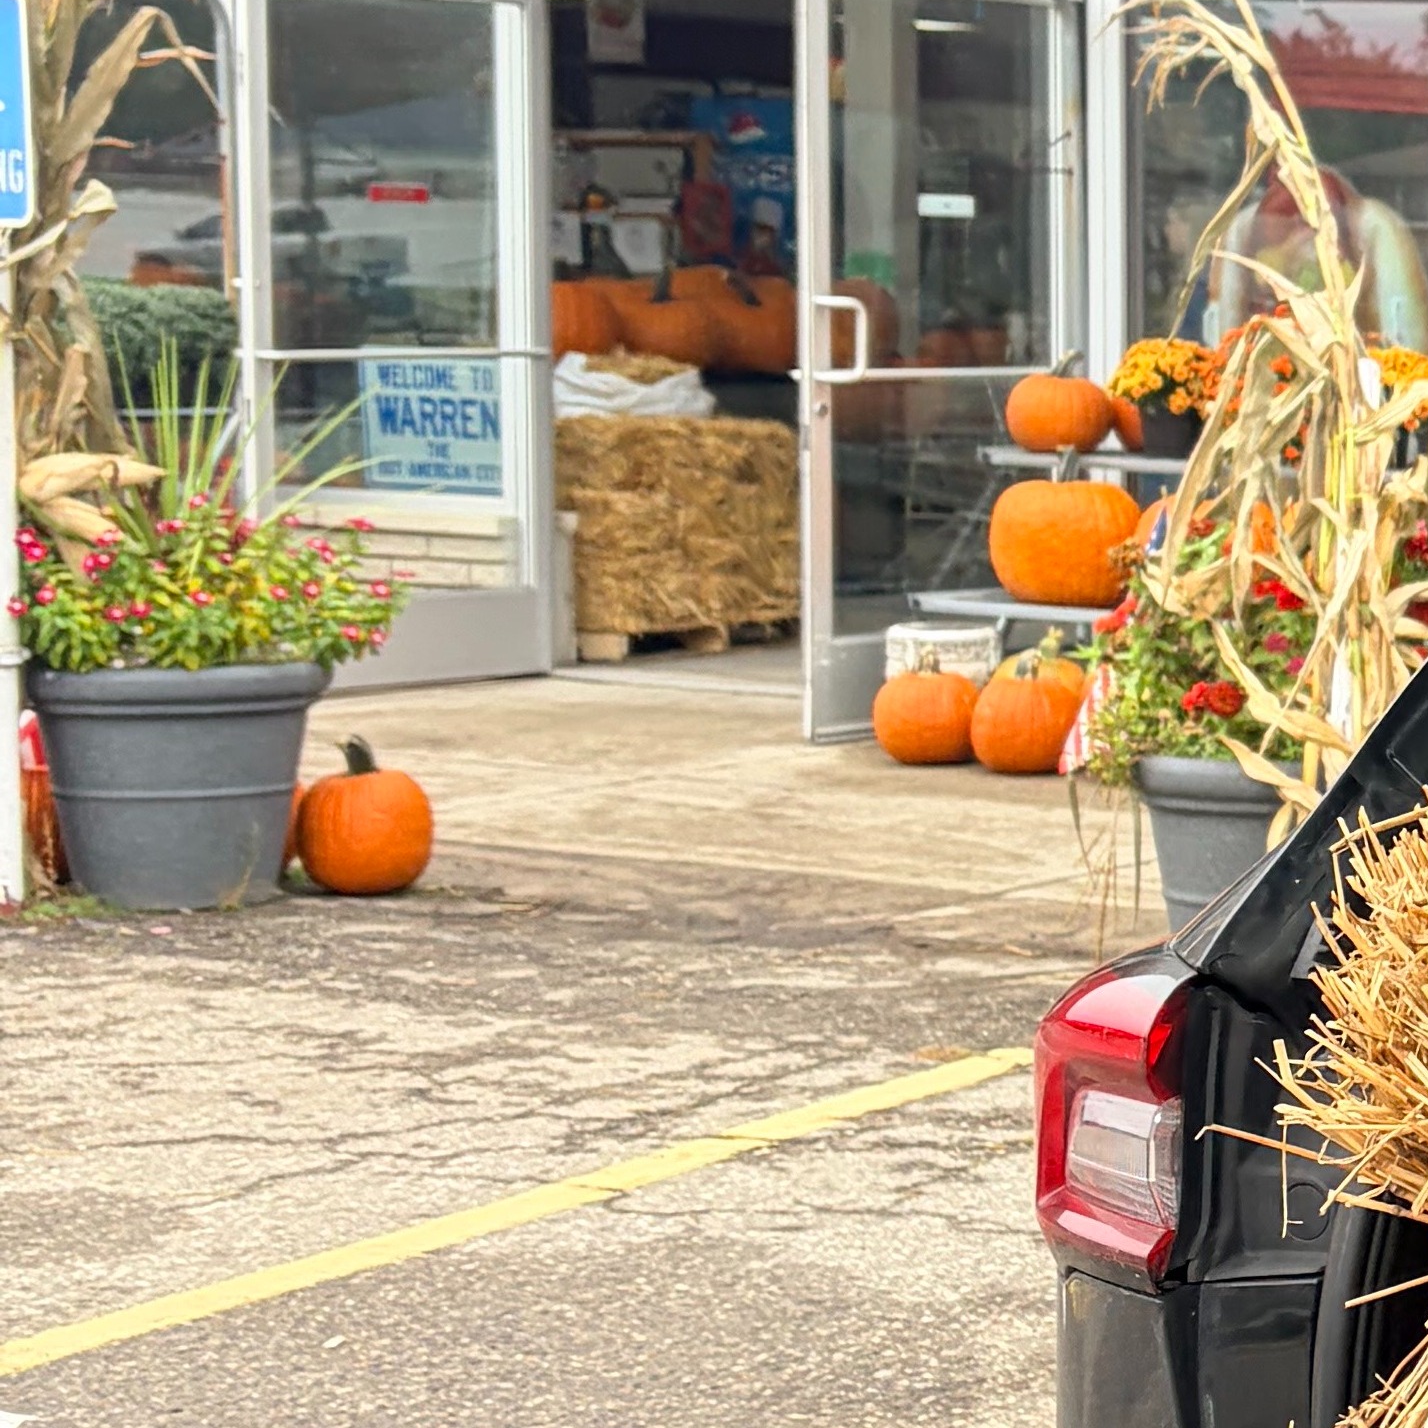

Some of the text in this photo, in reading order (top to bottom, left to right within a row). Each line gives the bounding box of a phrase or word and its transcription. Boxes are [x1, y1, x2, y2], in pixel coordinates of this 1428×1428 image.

[378, 364, 493, 391] WELCOME TO
[376, 395, 501, 441] WARREN
